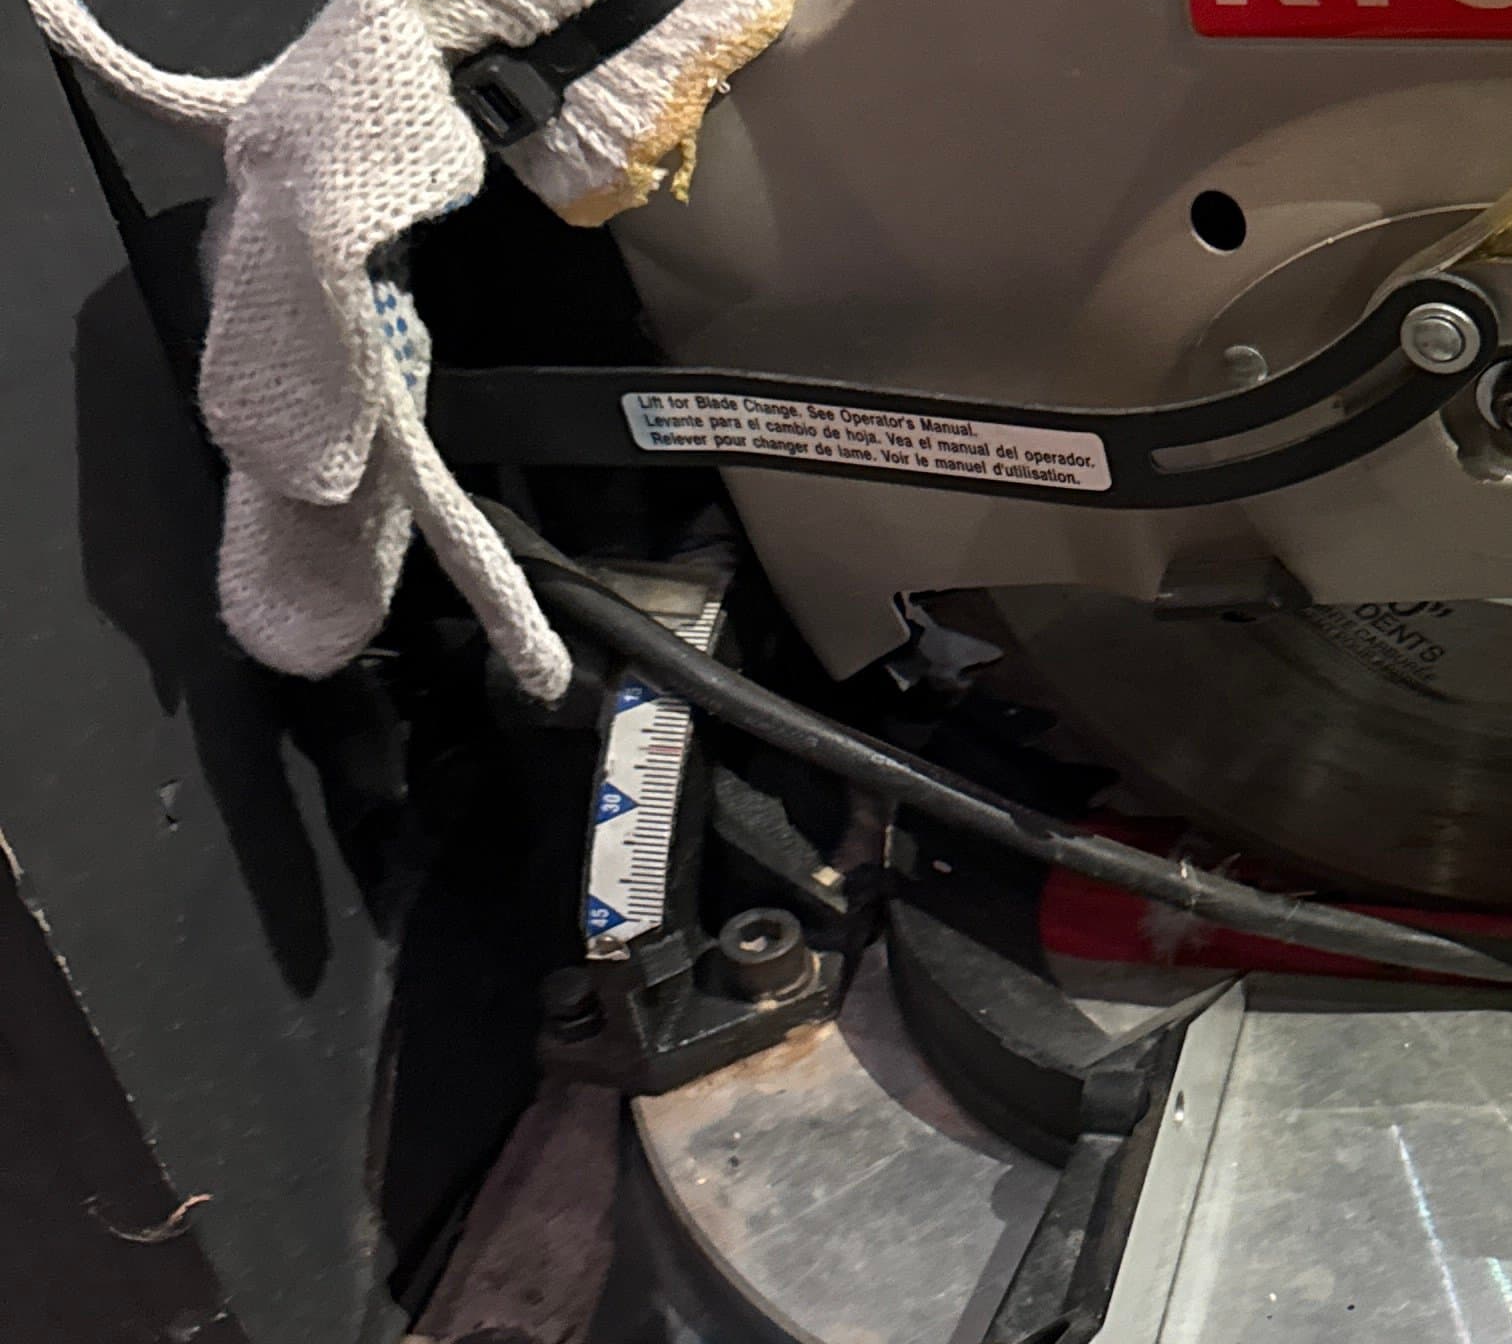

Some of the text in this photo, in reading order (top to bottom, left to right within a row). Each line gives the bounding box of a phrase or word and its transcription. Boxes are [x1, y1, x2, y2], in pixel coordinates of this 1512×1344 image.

[638, 396, 662, 409] Lift
[668, 397, 689, 410] for
[696, 396, 738, 411] Blade
[806, 405, 835, 421] See
[840, 409, 915, 430] Operator's
[920, 418, 978, 436] Manual.
[644, 414, 1095, 469] Levante para el cambio de hoja. Vea el manual del operador.
[650, 431, 1081, 485] Relever pour changer de lame. Voir le manuel d'utilisation.
[1354, 602, 1446, 663] DENTS
[602, 794, 622, 814] 30
[590, 908, 610, 928] 45
